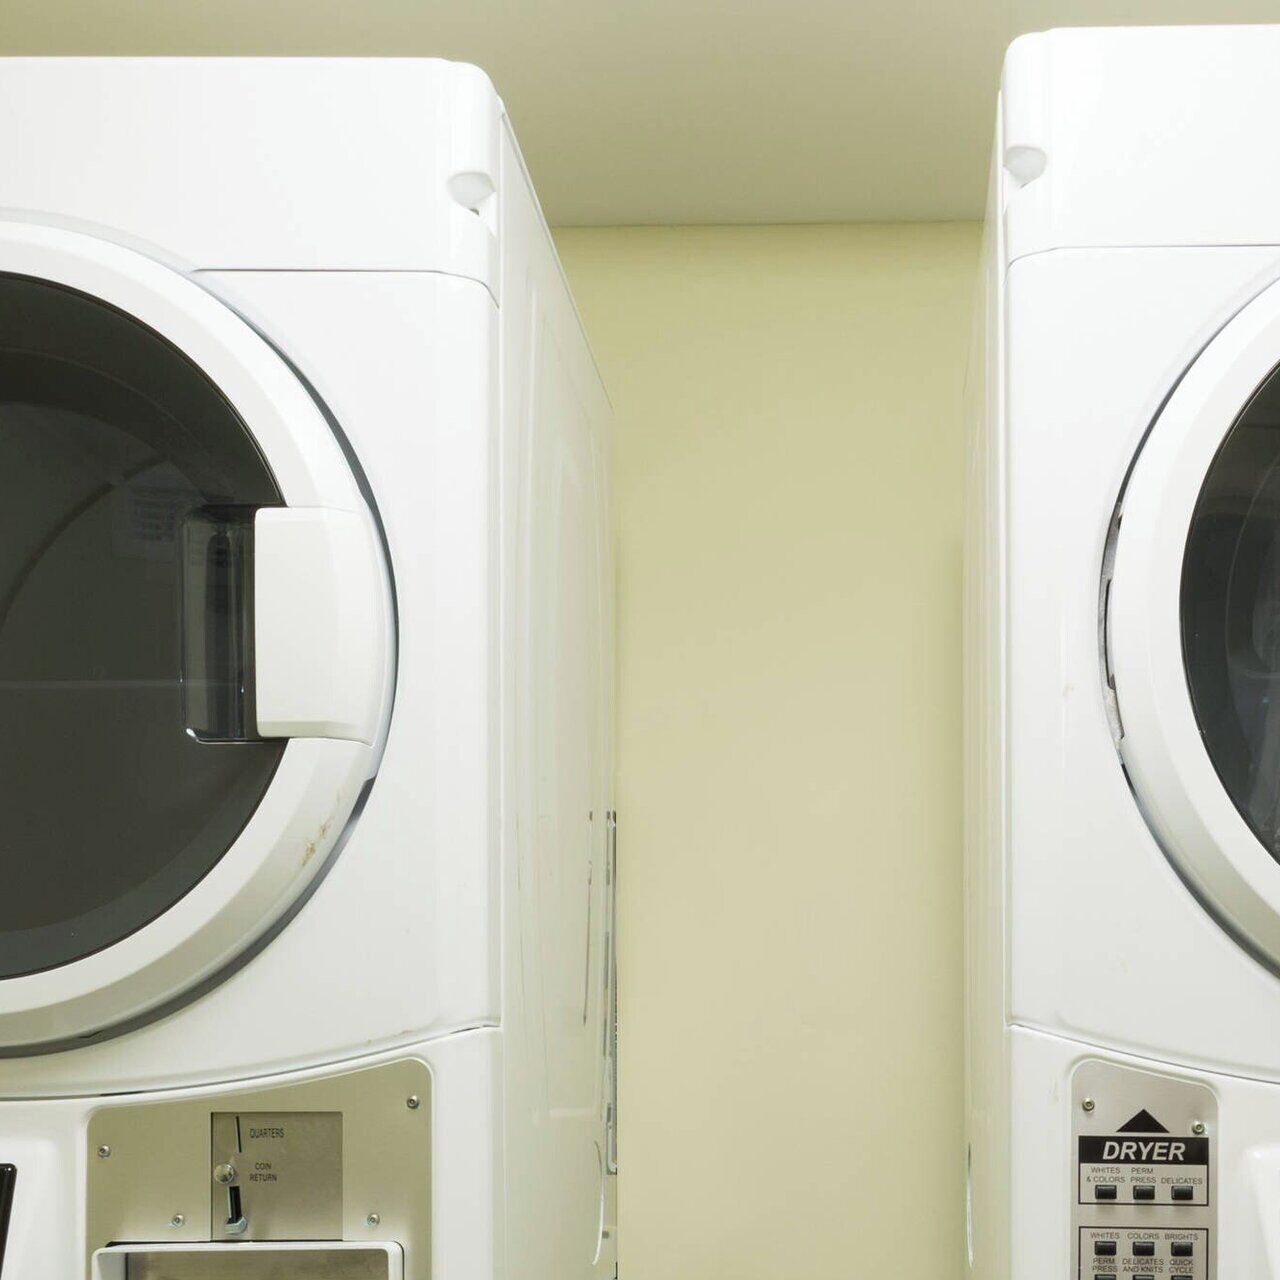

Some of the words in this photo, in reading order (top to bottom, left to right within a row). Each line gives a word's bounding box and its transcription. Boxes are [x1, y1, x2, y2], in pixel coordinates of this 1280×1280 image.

[249, 1128, 285, 1138] QUARTERS
[1103, 1141, 1186, 1161] DRYER
[255, 1162, 272, 1170] COIN
[249, 1173, 277, 1181] RETURN
[1130, 1176, 1156, 1184] PRESS
[1161, 1177, 1203, 1185] DELICATES
[1127, 1232, 1160, 1240] COLORS
